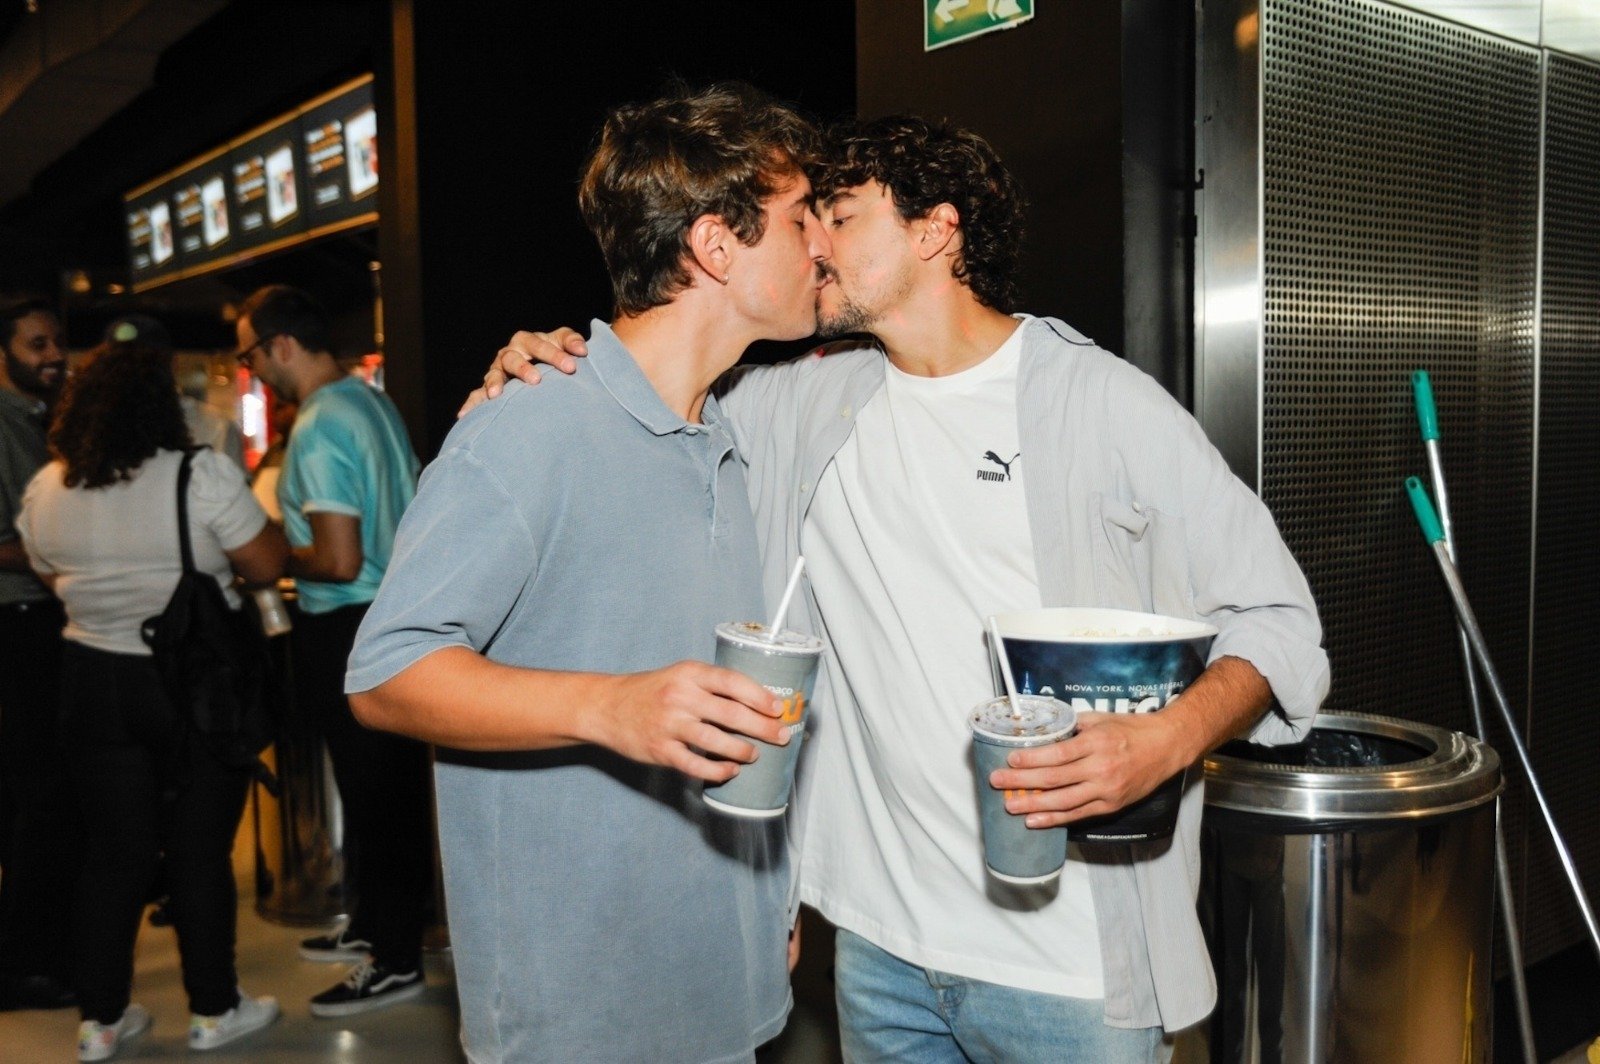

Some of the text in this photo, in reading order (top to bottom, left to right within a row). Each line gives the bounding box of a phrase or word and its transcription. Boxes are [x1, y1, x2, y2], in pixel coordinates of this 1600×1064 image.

[977, 470, 1005, 482] PUMA
[1065, 684, 1093, 692] NOVA
[1128, 684, 1158, 692] NOVAS
